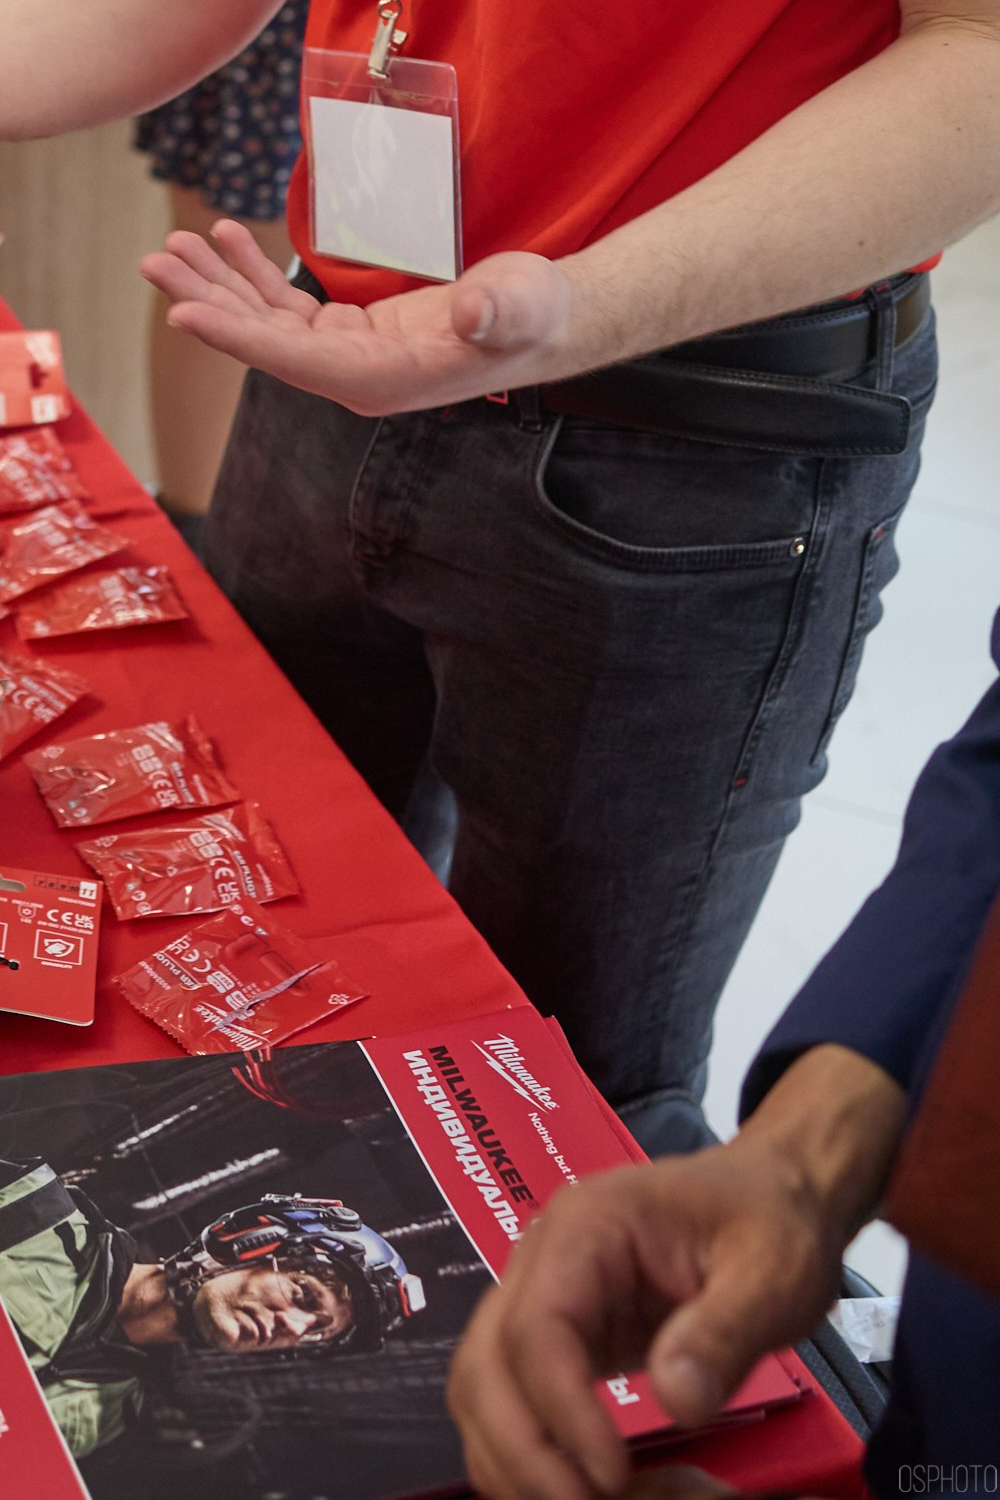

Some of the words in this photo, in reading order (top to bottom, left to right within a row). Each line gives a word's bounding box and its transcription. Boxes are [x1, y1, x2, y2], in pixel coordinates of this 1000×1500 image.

[82, 887, 95, 897] 11
[483, 1033, 556, 1111] Milwaukee
[528, 1111, 558, 1155] Nothing
[554, 1155, 571, 1175] but
